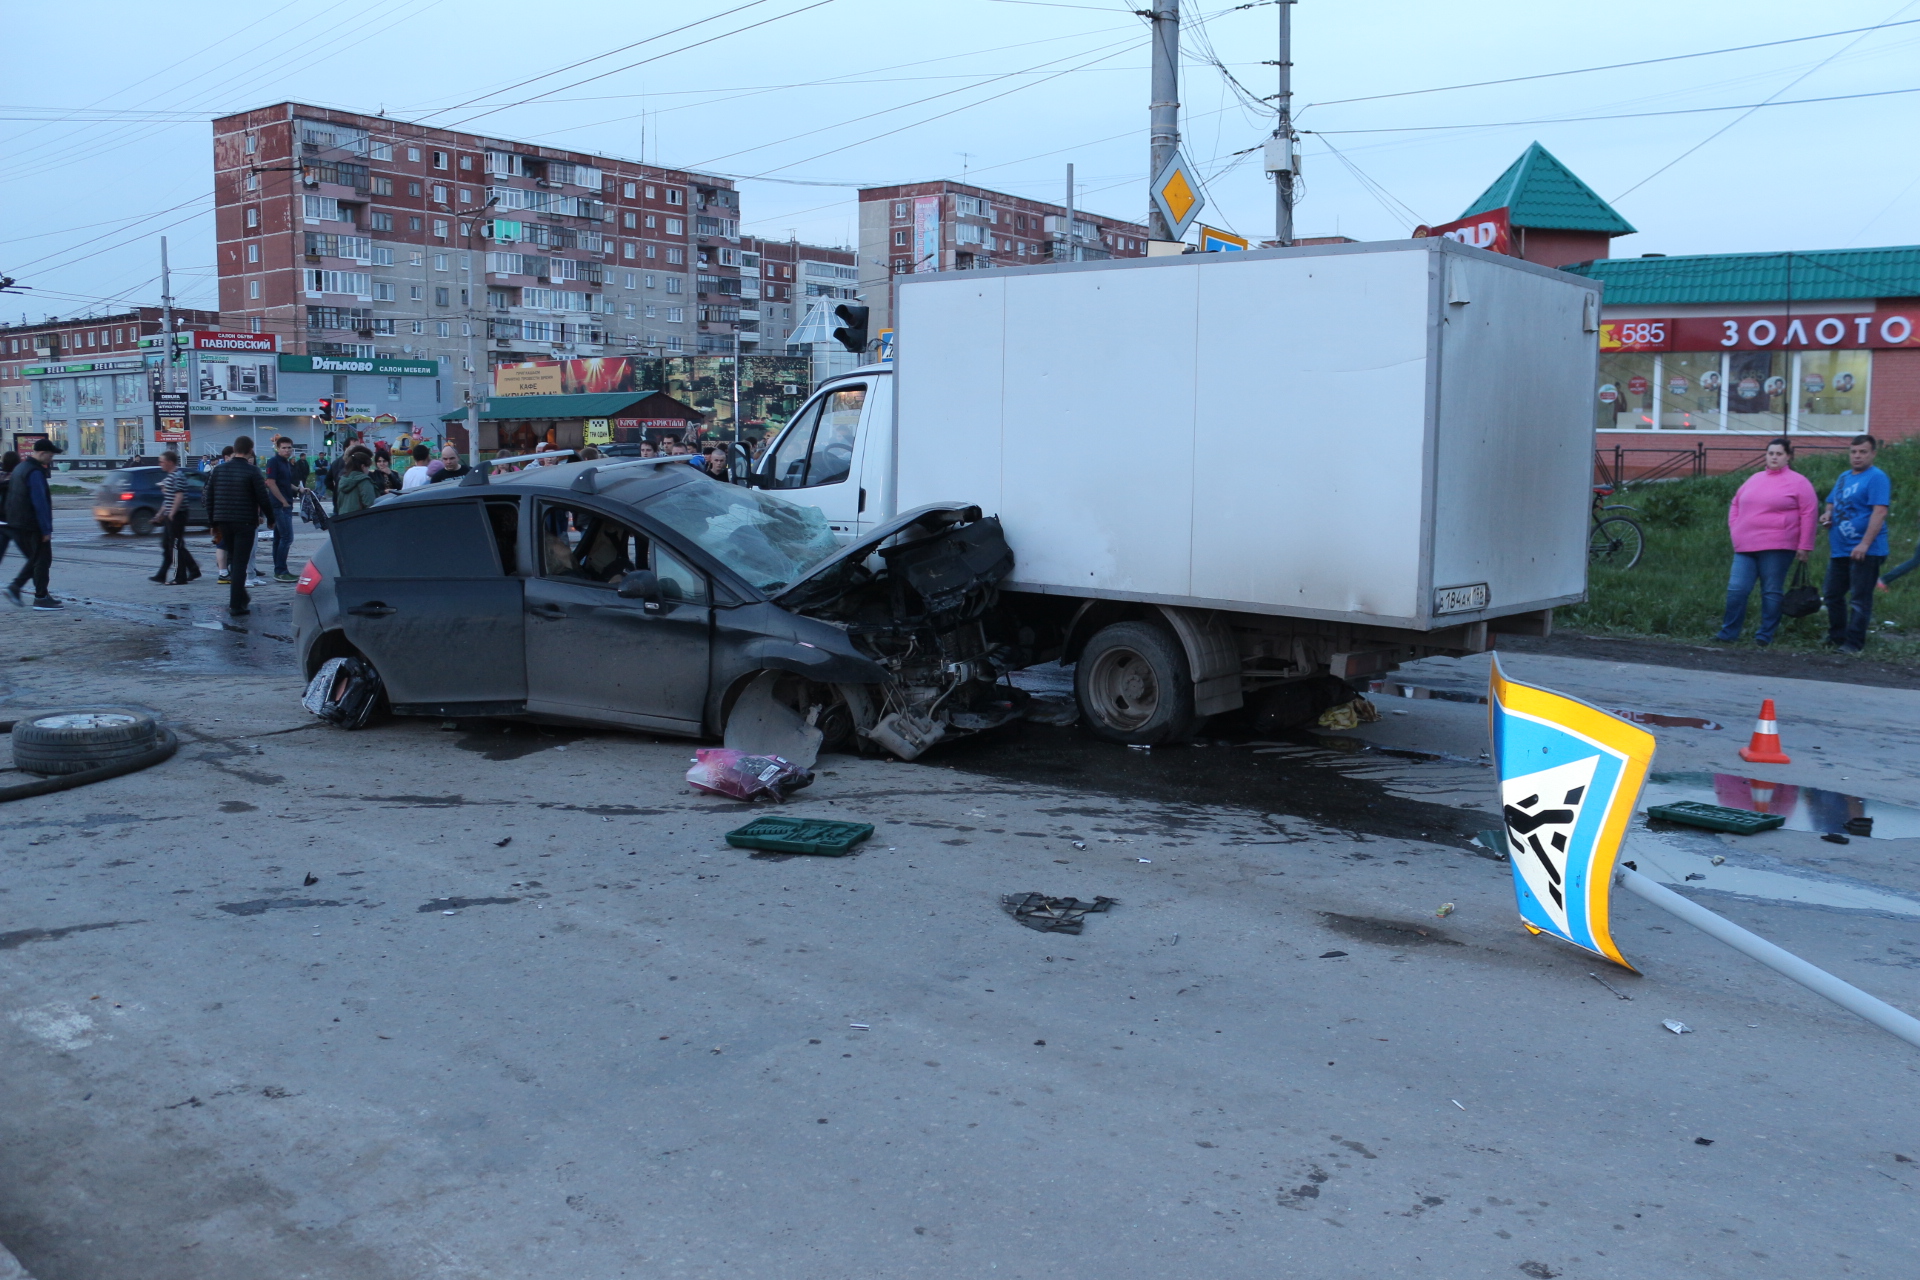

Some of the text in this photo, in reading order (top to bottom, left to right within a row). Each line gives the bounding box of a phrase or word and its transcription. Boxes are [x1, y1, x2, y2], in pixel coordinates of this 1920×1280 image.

[1621, 323, 1665, 343] 585
[1720, 316, 1912, 347] ЗОЛОТО
[201, 339, 271, 350] ПАВЛОВСКИЙ
[47, 366, 65, 374] SELA
[95, 362, 113, 370] SELA
